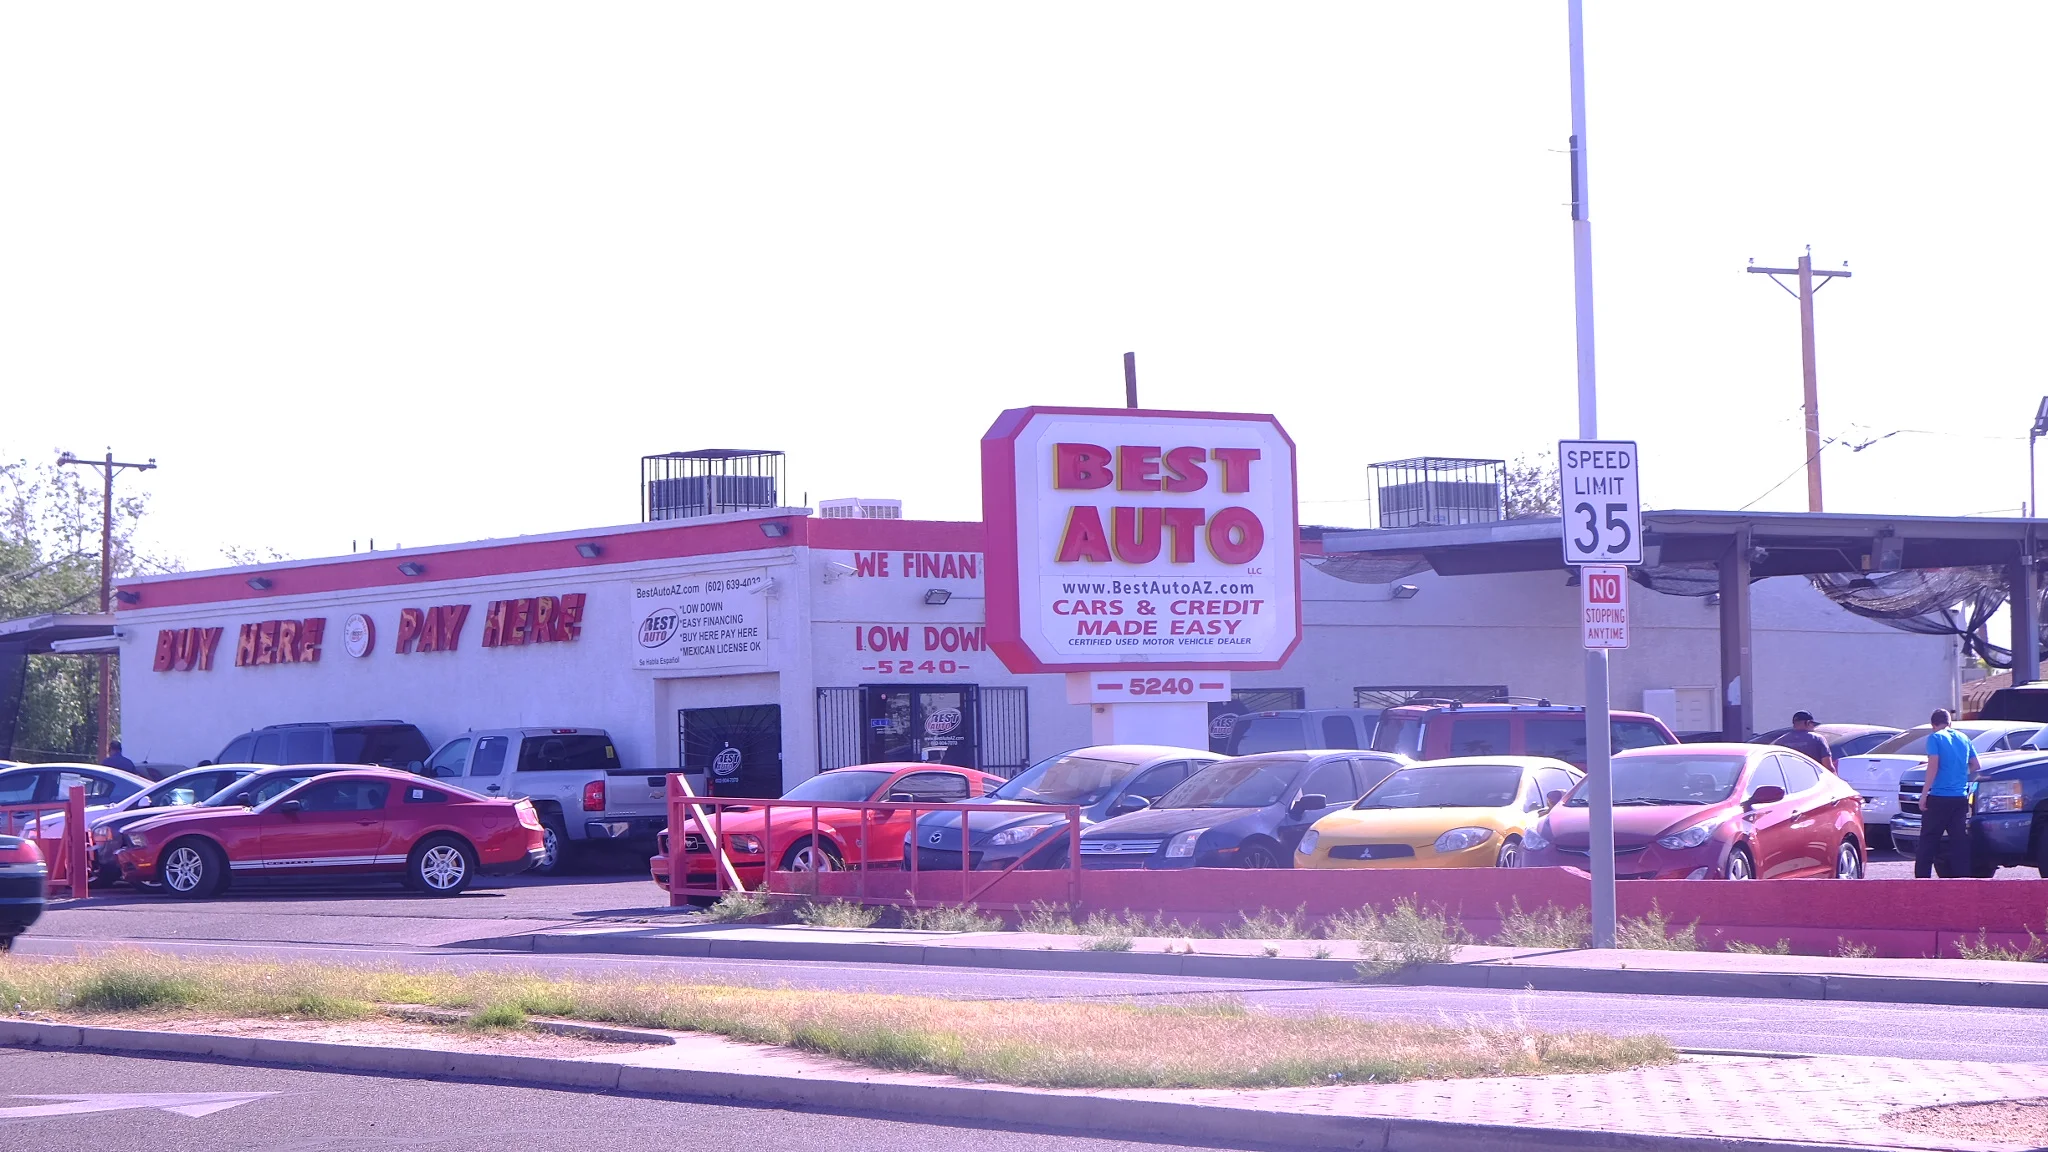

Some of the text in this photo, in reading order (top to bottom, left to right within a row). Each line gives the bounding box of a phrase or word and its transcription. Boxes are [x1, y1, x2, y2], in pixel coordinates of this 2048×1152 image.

[1567, 451, 1631, 469] SPEED
[1053, 443, 1261, 493] BEST
[1574, 477, 1625, 495] LIMIT
[1055, 505, 1265, 565] AUTO
[1574, 502, 1631, 554] 35
[854, 552, 889, 577] WE
[636, 584, 700, 598] BestAutoAZ.com
[705, 580, 725, 595] (602)
[1063, 580, 1254, 595] www.BestAutoAZ.com
[1593, 578, 1617, 599] NO
[700, 602, 723, 612] DOWN
[1053, 600, 1265, 615] CARS & CREDIT
[644, 615, 677, 631] BEST
[703, 614, 744, 626] FINANCING
[1586, 608, 1625, 623] STOPPING
[395, 605, 471, 654] PAY
[482, 593, 587, 648] HERE
[1077, 620, 1243, 635] MADE EASY
[643, 631, 667, 643] AUTO
[699, 630, 719, 641] HERE
[720, 629, 737, 639] PAY
[738, 627, 758, 637] HERE
[1588, 628, 1624, 639] ANYTIME
[153, 627, 224, 672] BUY
[235, 617, 327, 667] HERE
[717, 643, 748, 653] LICENSE
[749, 641, 761, 651] OK
[1068, 638, 1112, 646] CERTIFIED
[1115, 638, 1139, 646] USED
[1142, 638, 1175, 646] MOTOR
[1217, 637, 1252, 645] DEALER
[660, 656, 680, 665] Español
[930, 713, 959, 723] BEST
[929, 722, 952, 730] AUTO
